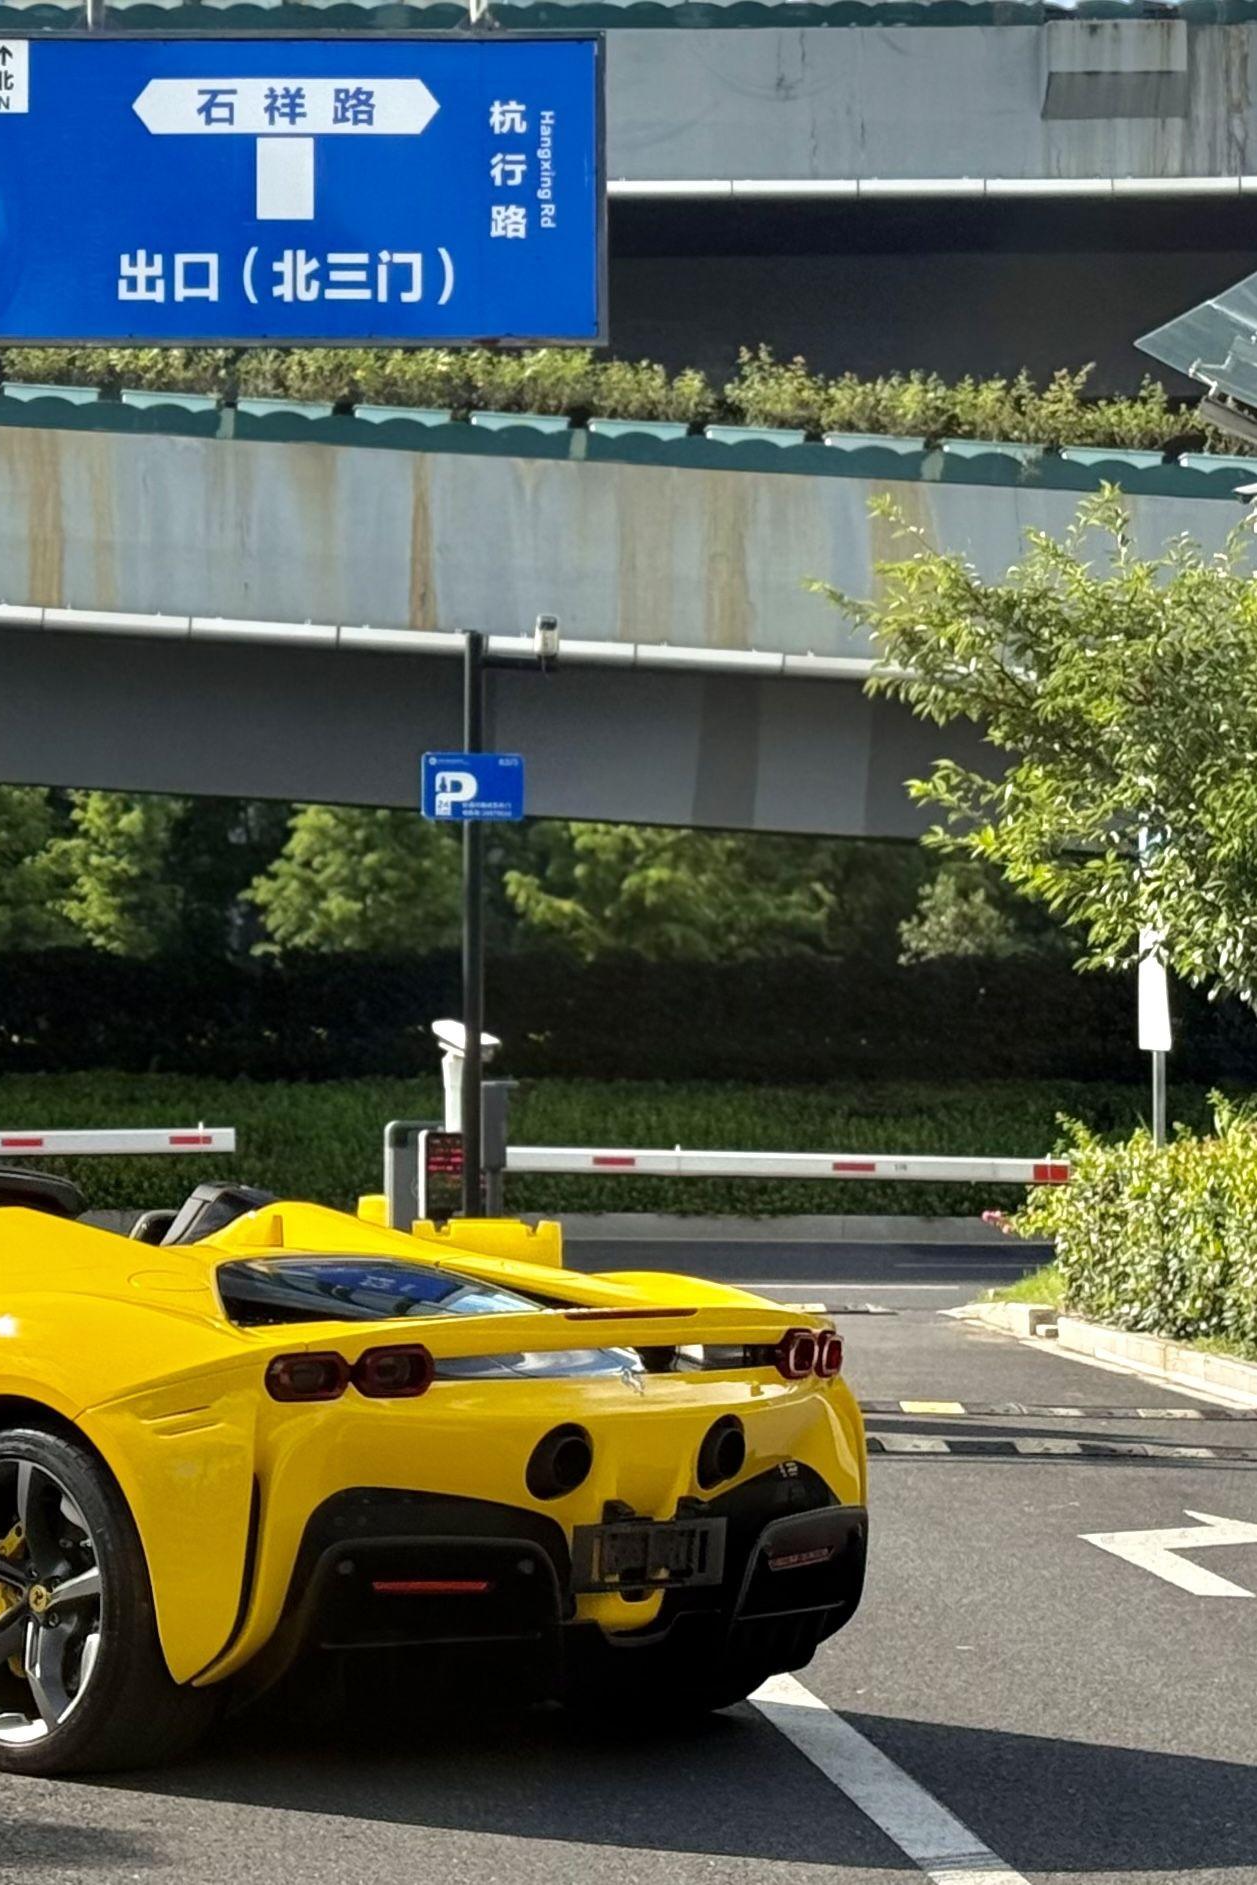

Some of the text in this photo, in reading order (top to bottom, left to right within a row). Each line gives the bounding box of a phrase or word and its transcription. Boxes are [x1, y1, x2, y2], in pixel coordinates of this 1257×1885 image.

[196, 86, 376, 126] 石祥路
[489, 100, 527, 239] 杭行路
[537, 110, 556, 228] Hangxing Rd
[435, 771, 478, 816] P
